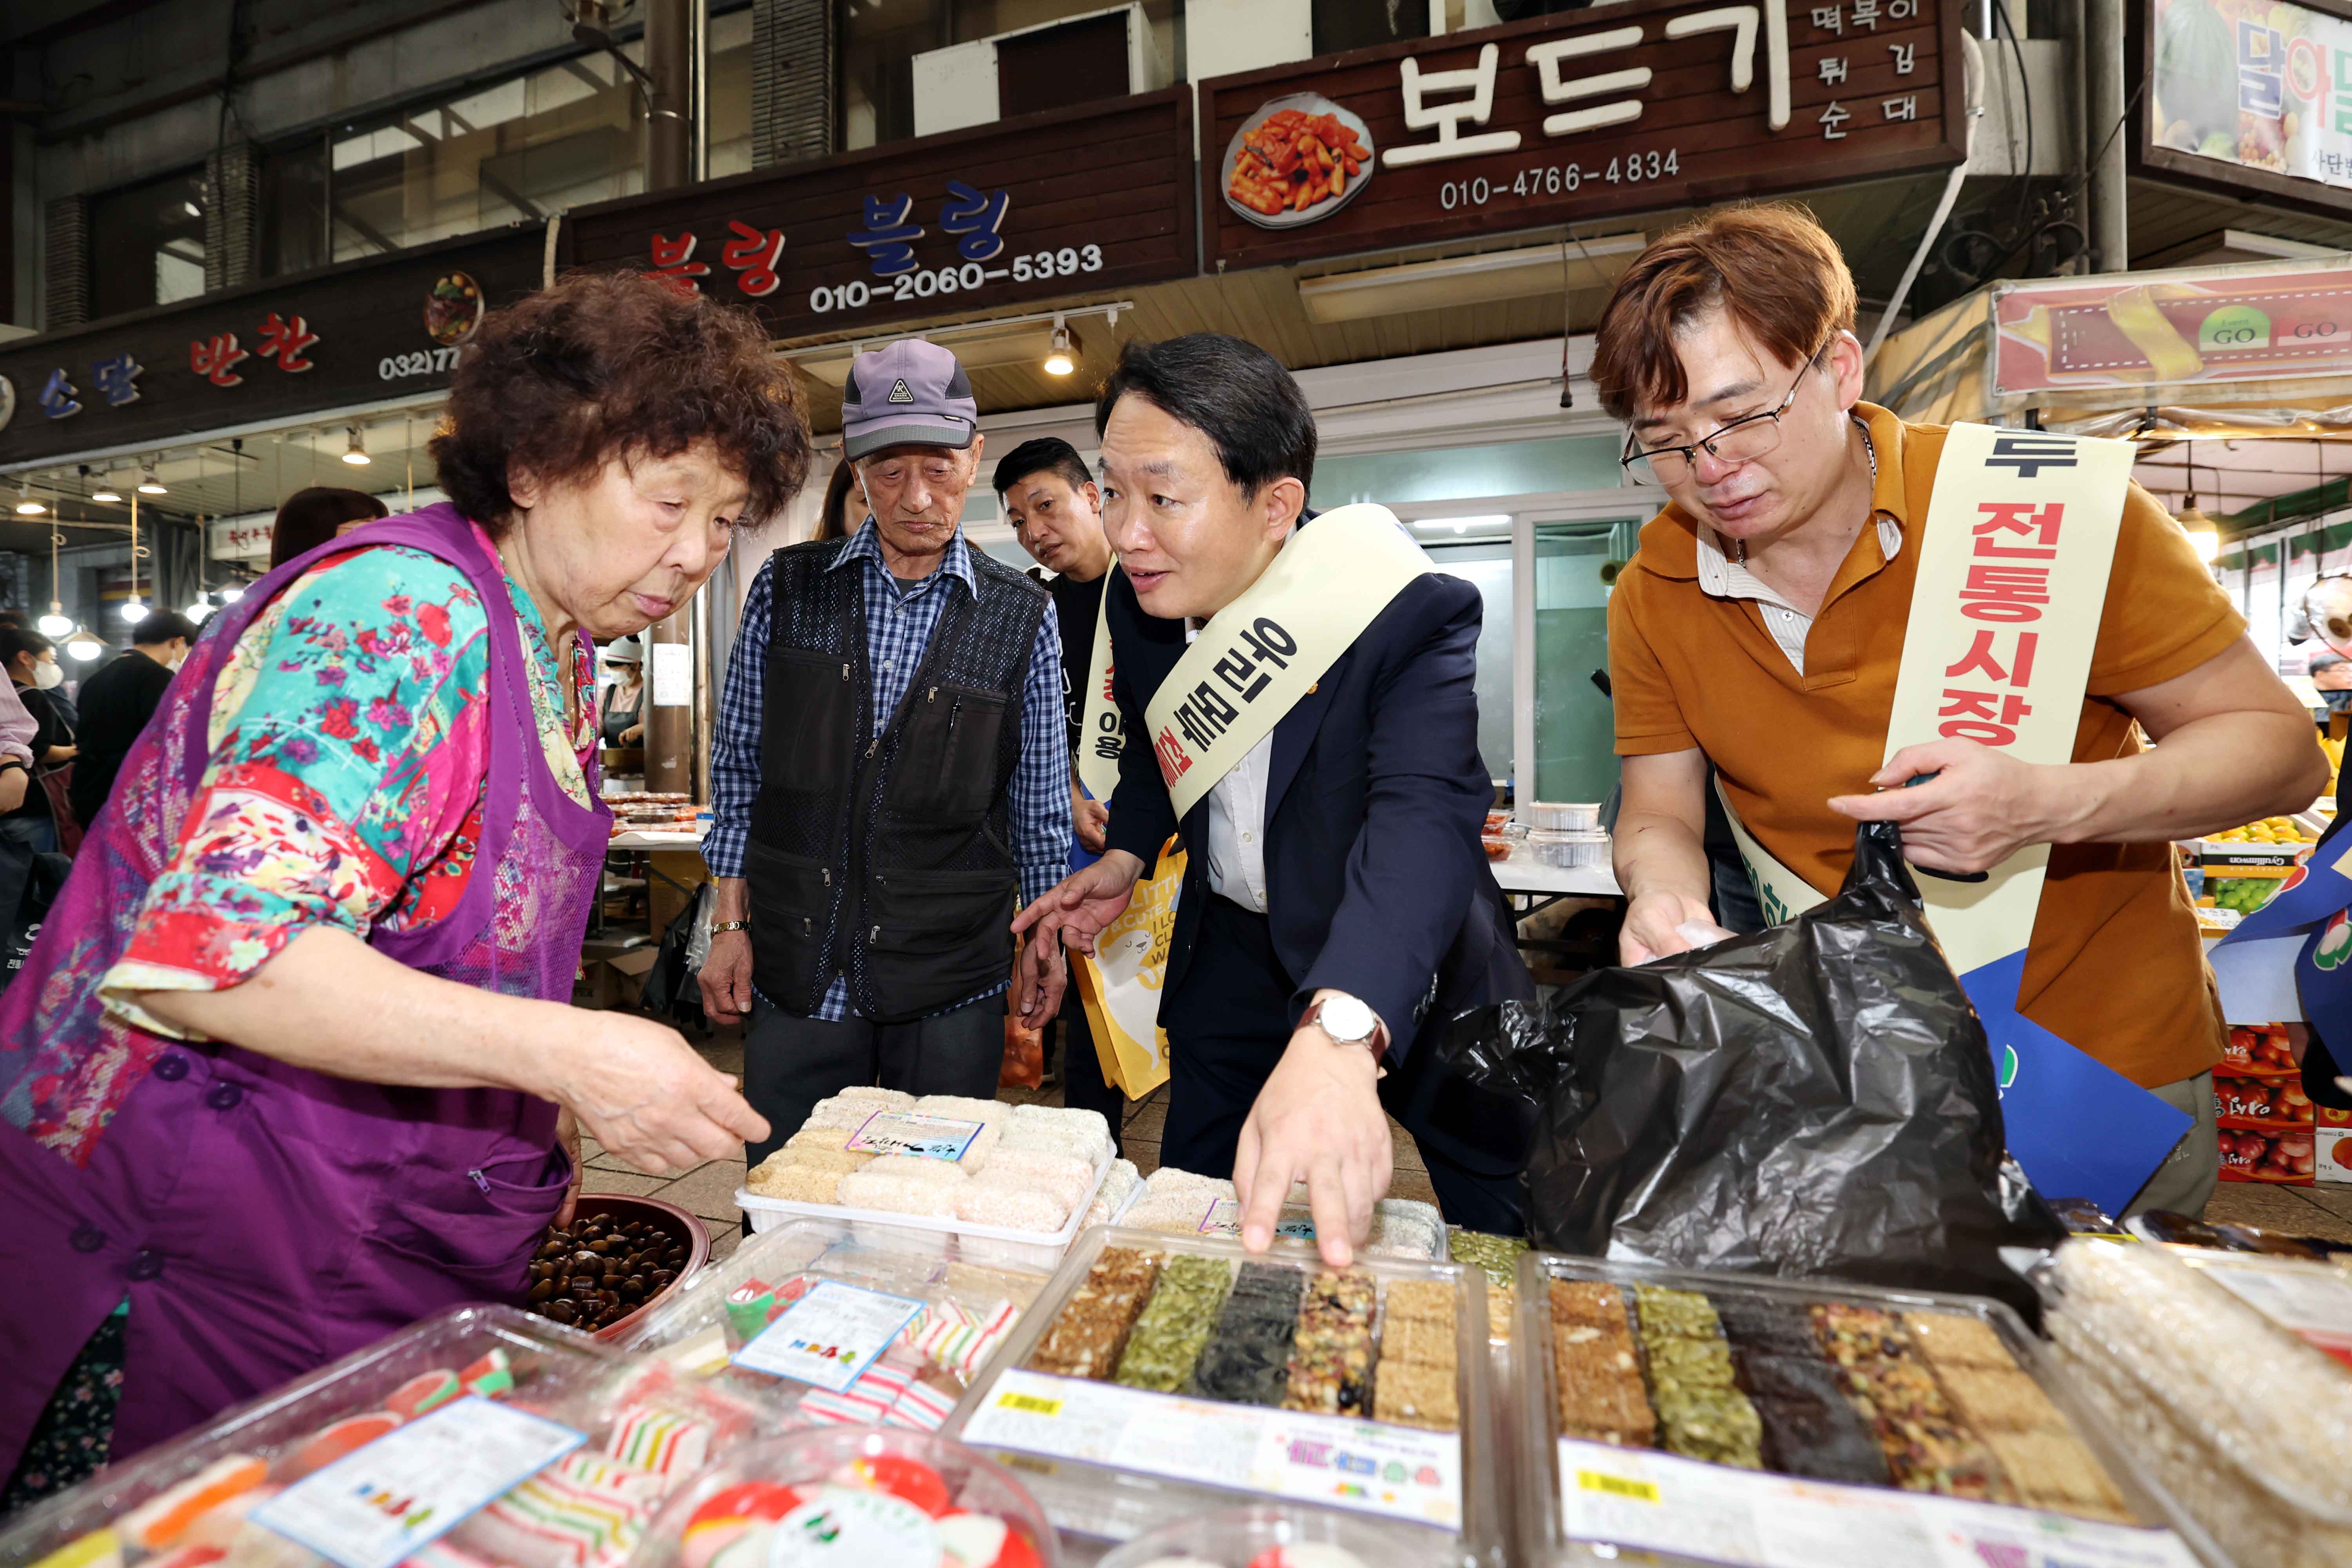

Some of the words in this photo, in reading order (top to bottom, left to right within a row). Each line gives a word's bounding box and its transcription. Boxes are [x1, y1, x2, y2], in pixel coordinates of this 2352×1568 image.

[1382, 0, 1791, 169] 보드기
[1441, 148, 1680, 210] 010-4766-4834
[810, 244, 1103, 313] 010-2060-5393
[191, 313, 320, 387] 반찬
[2213, 328, 2256, 345] GO
[2294, 321, 2337, 338] GO
[1984, 430, 2082, 477] 두
[1938, 502, 2065, 747] 전통시장
[1212, 617, 1298, 704] 우리
[1173, 680, 1240, 753] 모두
